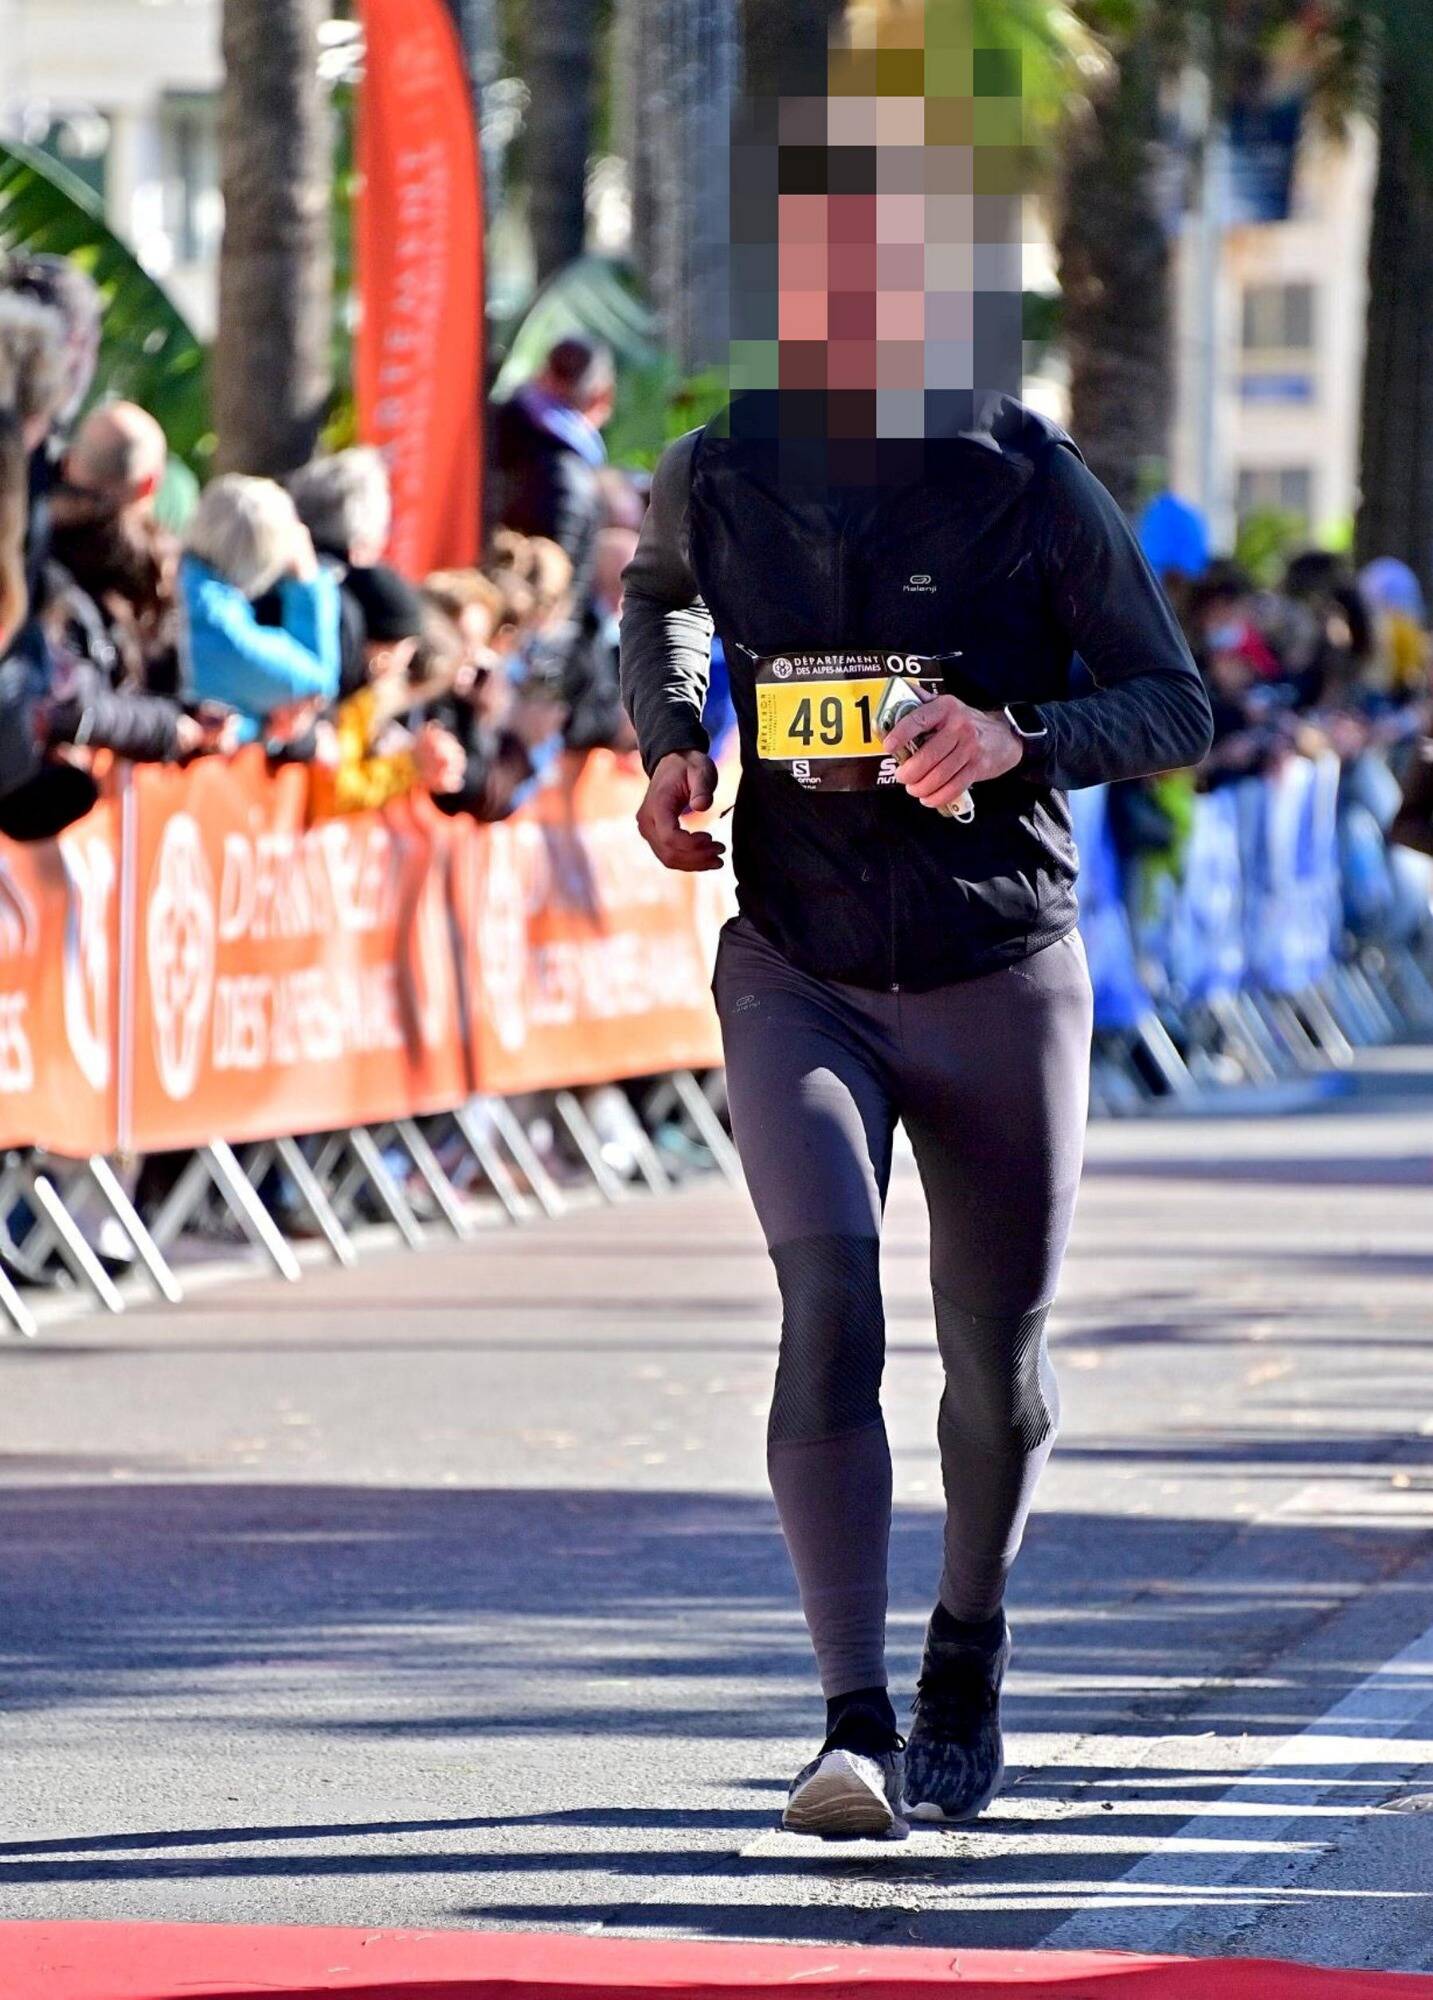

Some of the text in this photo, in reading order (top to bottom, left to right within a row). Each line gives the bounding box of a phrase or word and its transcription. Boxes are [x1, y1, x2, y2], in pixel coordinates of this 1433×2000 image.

[794, 655, 879, 667] DÉPARTEMENT
[886, 654, 922, 675] 06
[796, 666, 811, 676] DES
